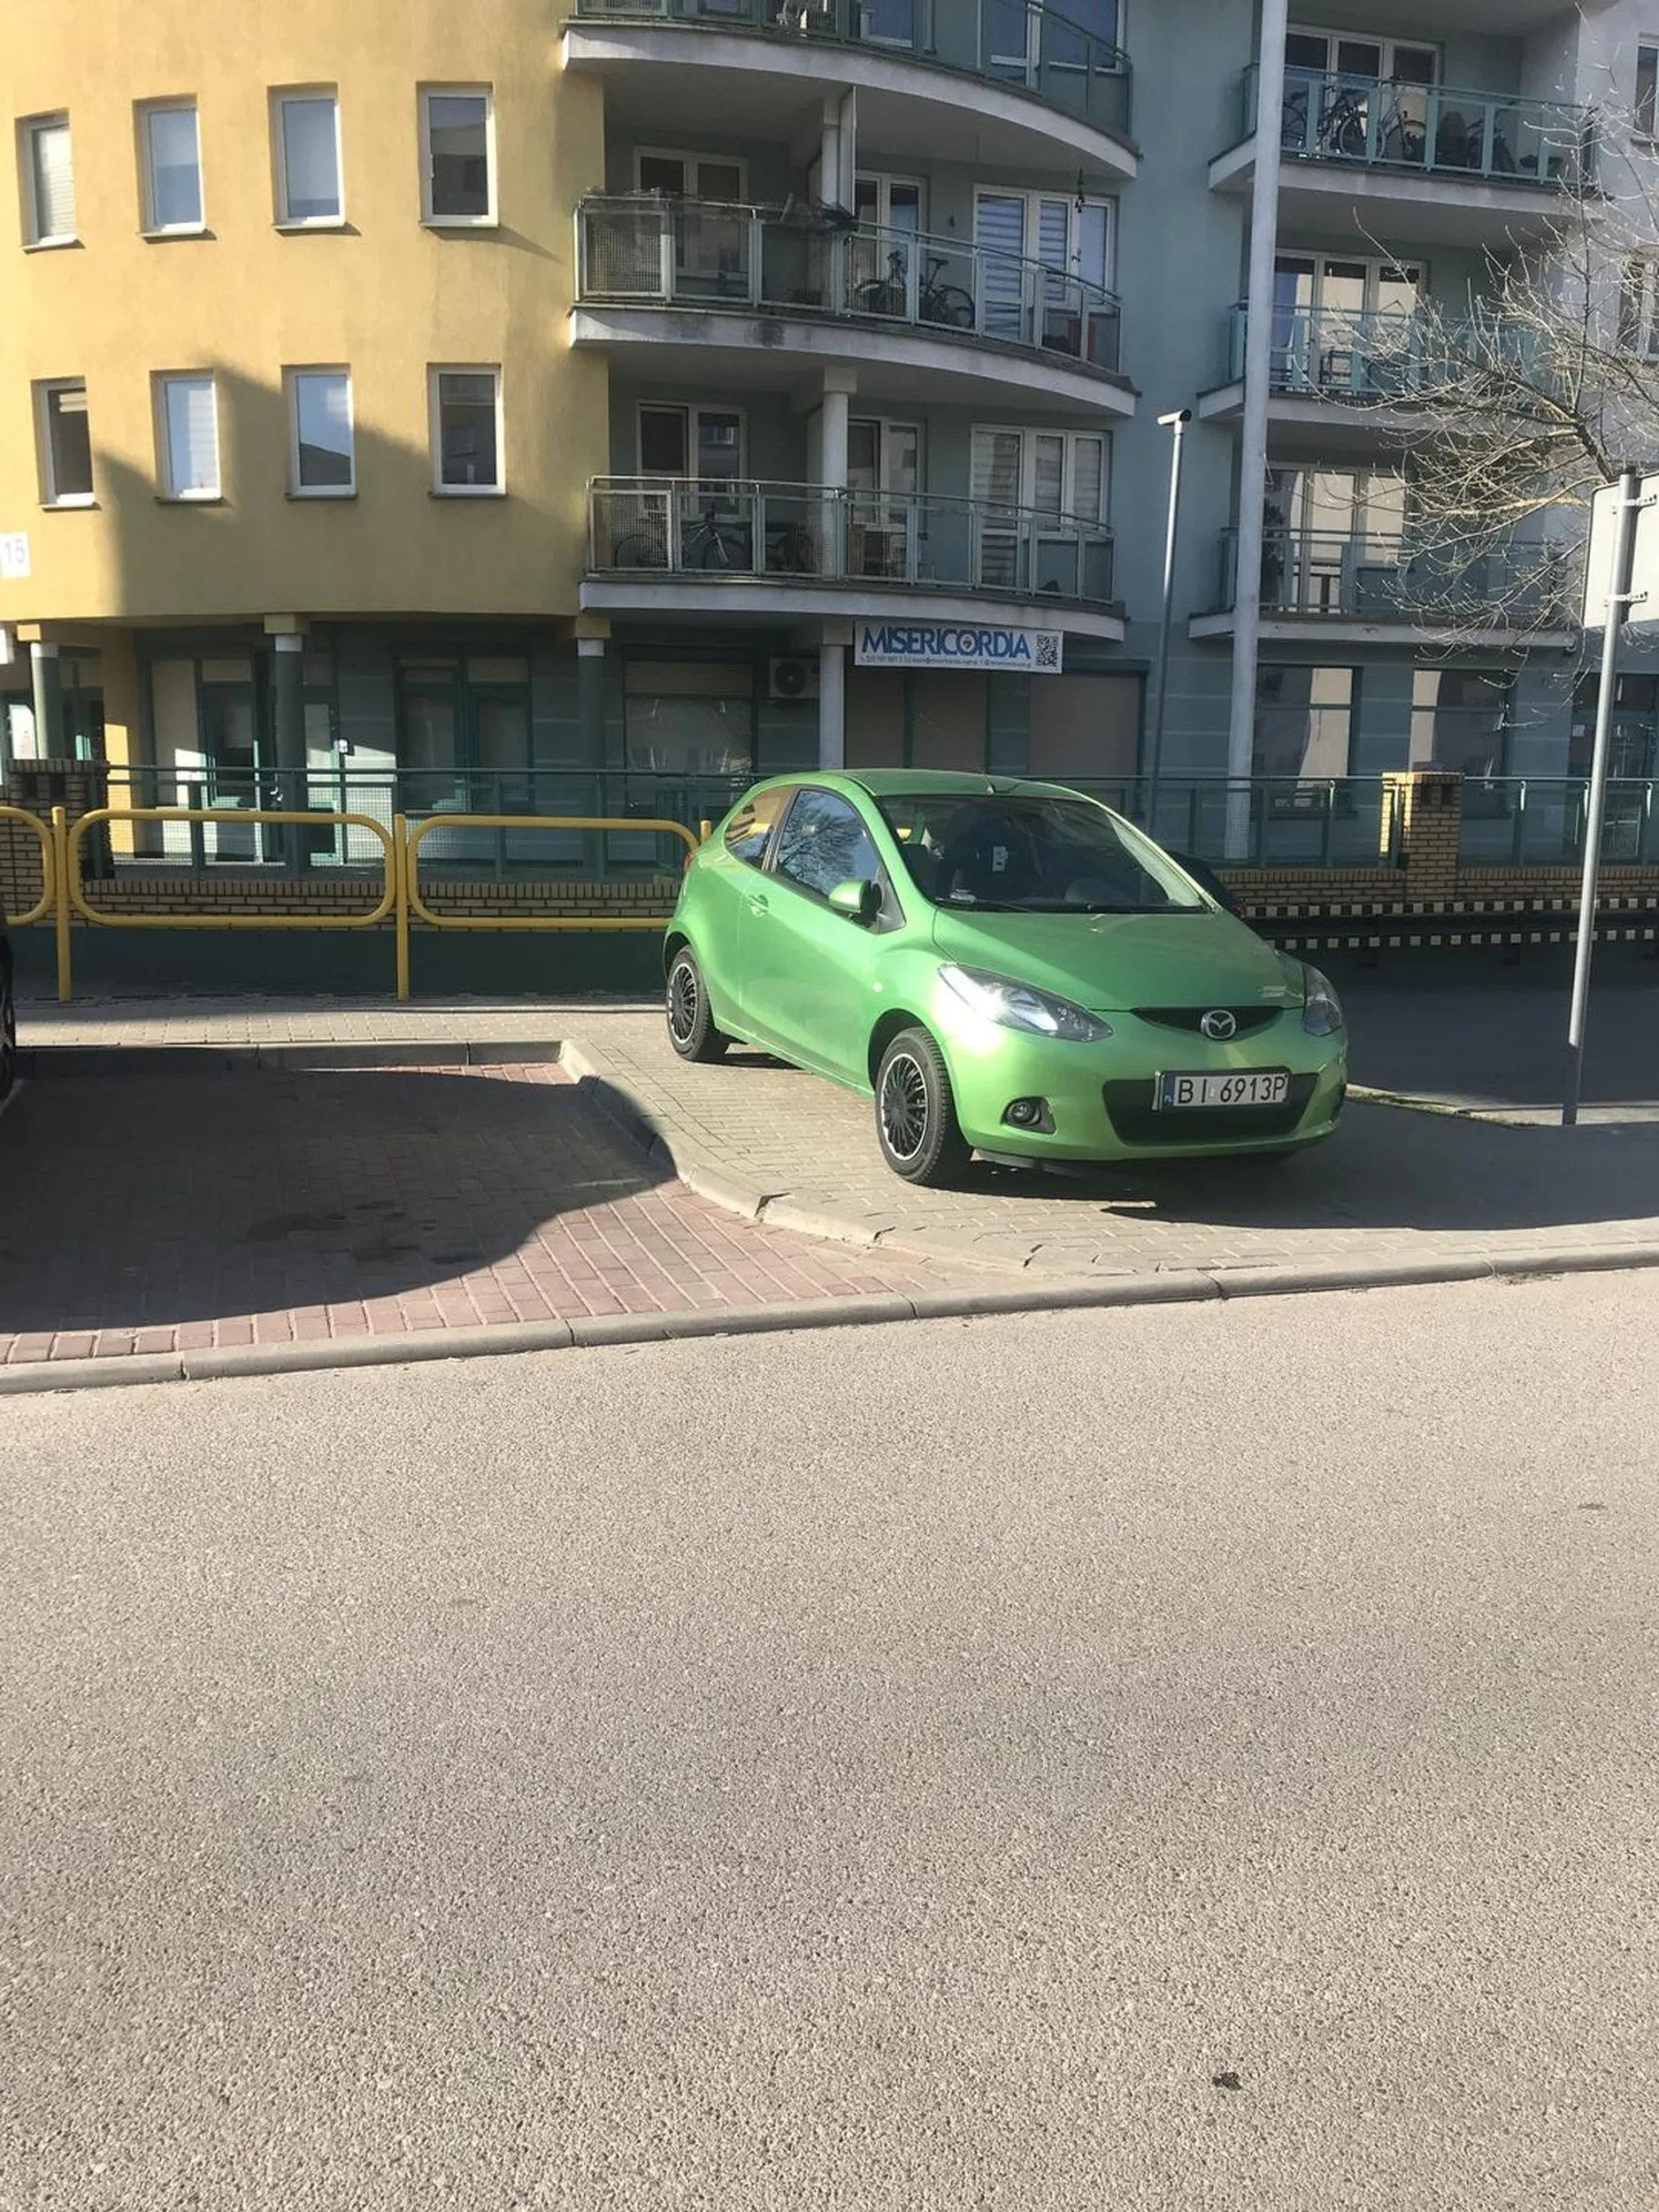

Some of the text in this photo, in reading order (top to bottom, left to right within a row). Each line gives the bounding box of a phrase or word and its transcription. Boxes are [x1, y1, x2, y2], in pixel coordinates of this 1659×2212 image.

[4, 538, 26, 566] 15
[861, 626, 1031, 659] MISERICORDIA
[1219, 1076, 1286, 1103] 6913P
